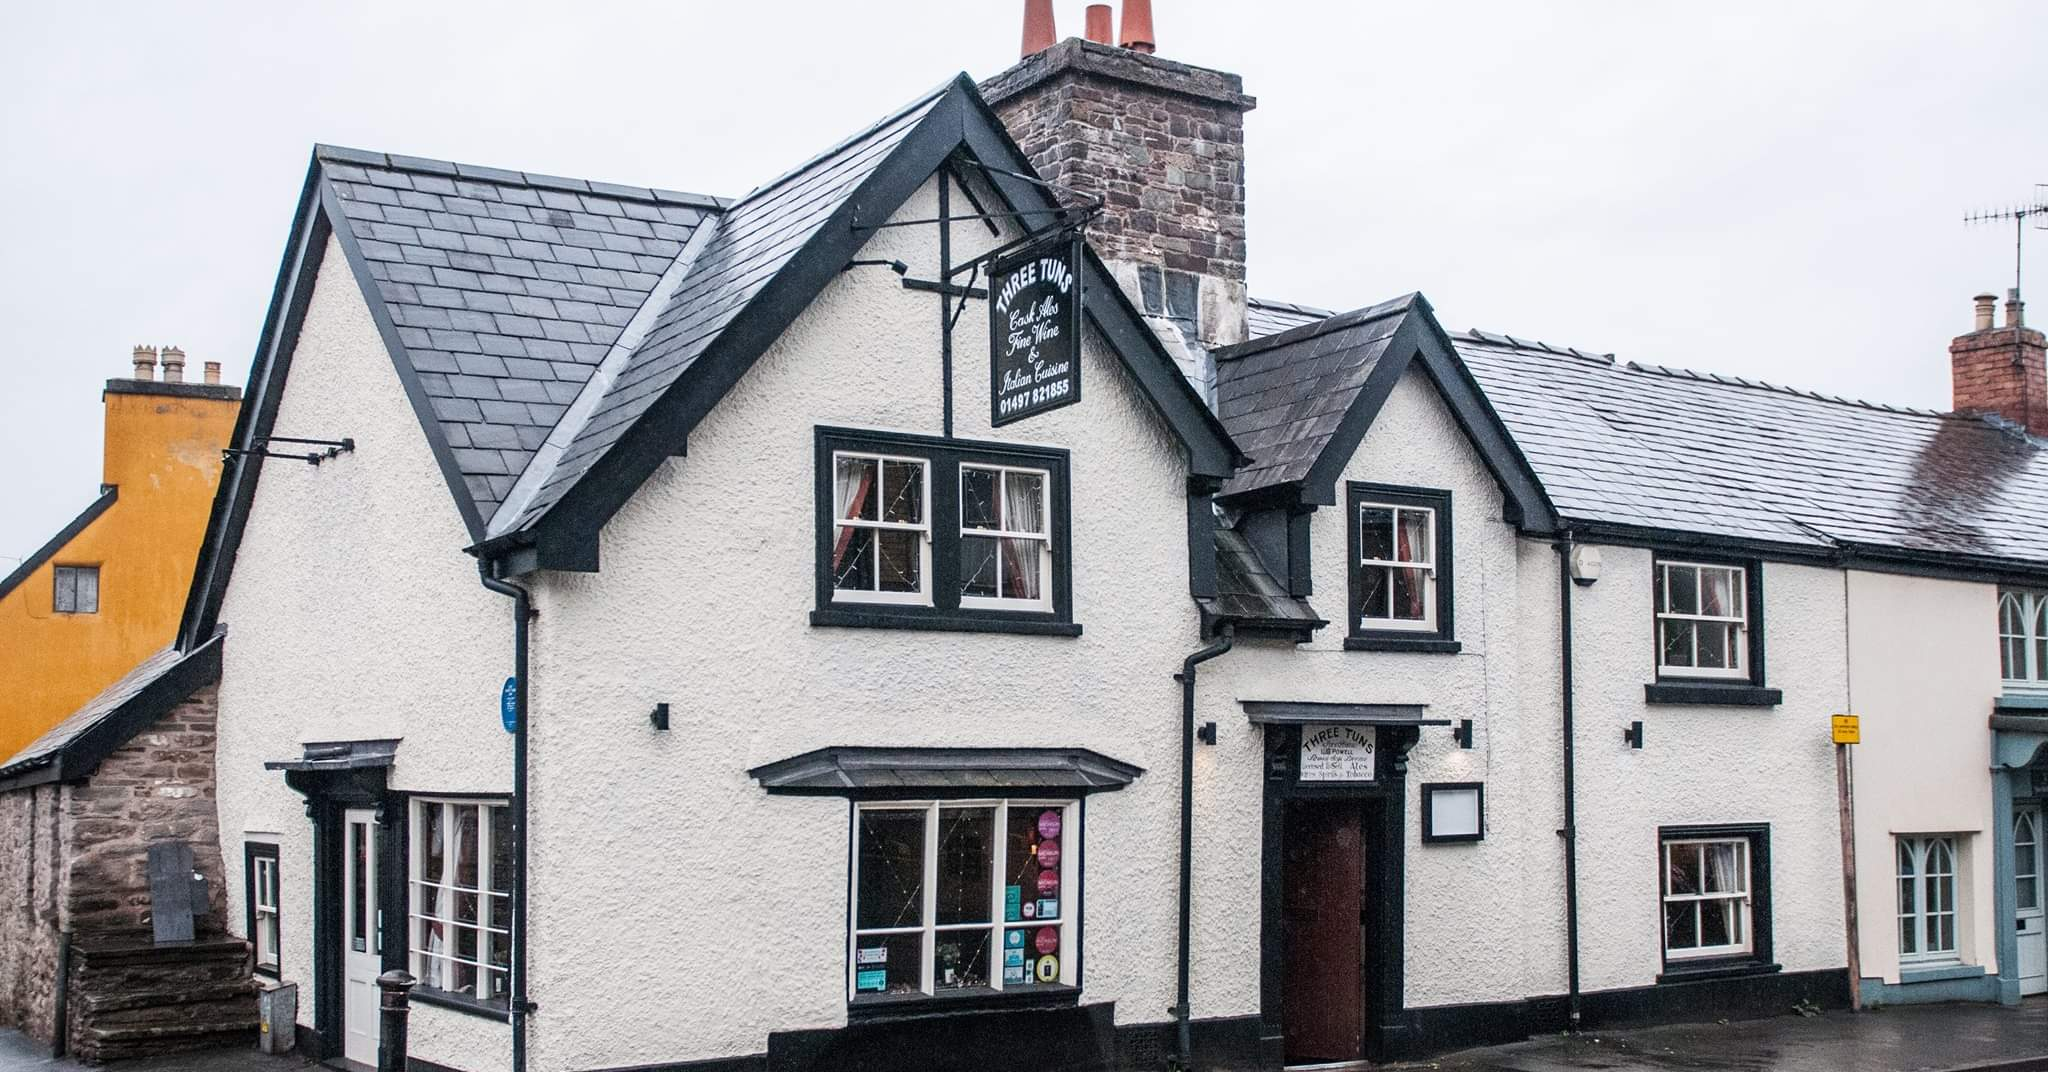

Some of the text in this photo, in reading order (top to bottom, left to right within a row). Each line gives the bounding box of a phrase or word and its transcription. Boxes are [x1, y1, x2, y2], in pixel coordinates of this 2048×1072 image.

[996, 258, 1073, 314] THREE TUNS
[1009, 295, 1059, 331] Cask Ales
[1006, 319, 1060, 357] Fine Wine
[1028, 346, 1040, 364] &
[998, 360, 1069, 395] Italian Cuisine
[1000, 379, 1069, 414] 01497 821855
[1303, 727, 1373, 754] THREE TUNS
